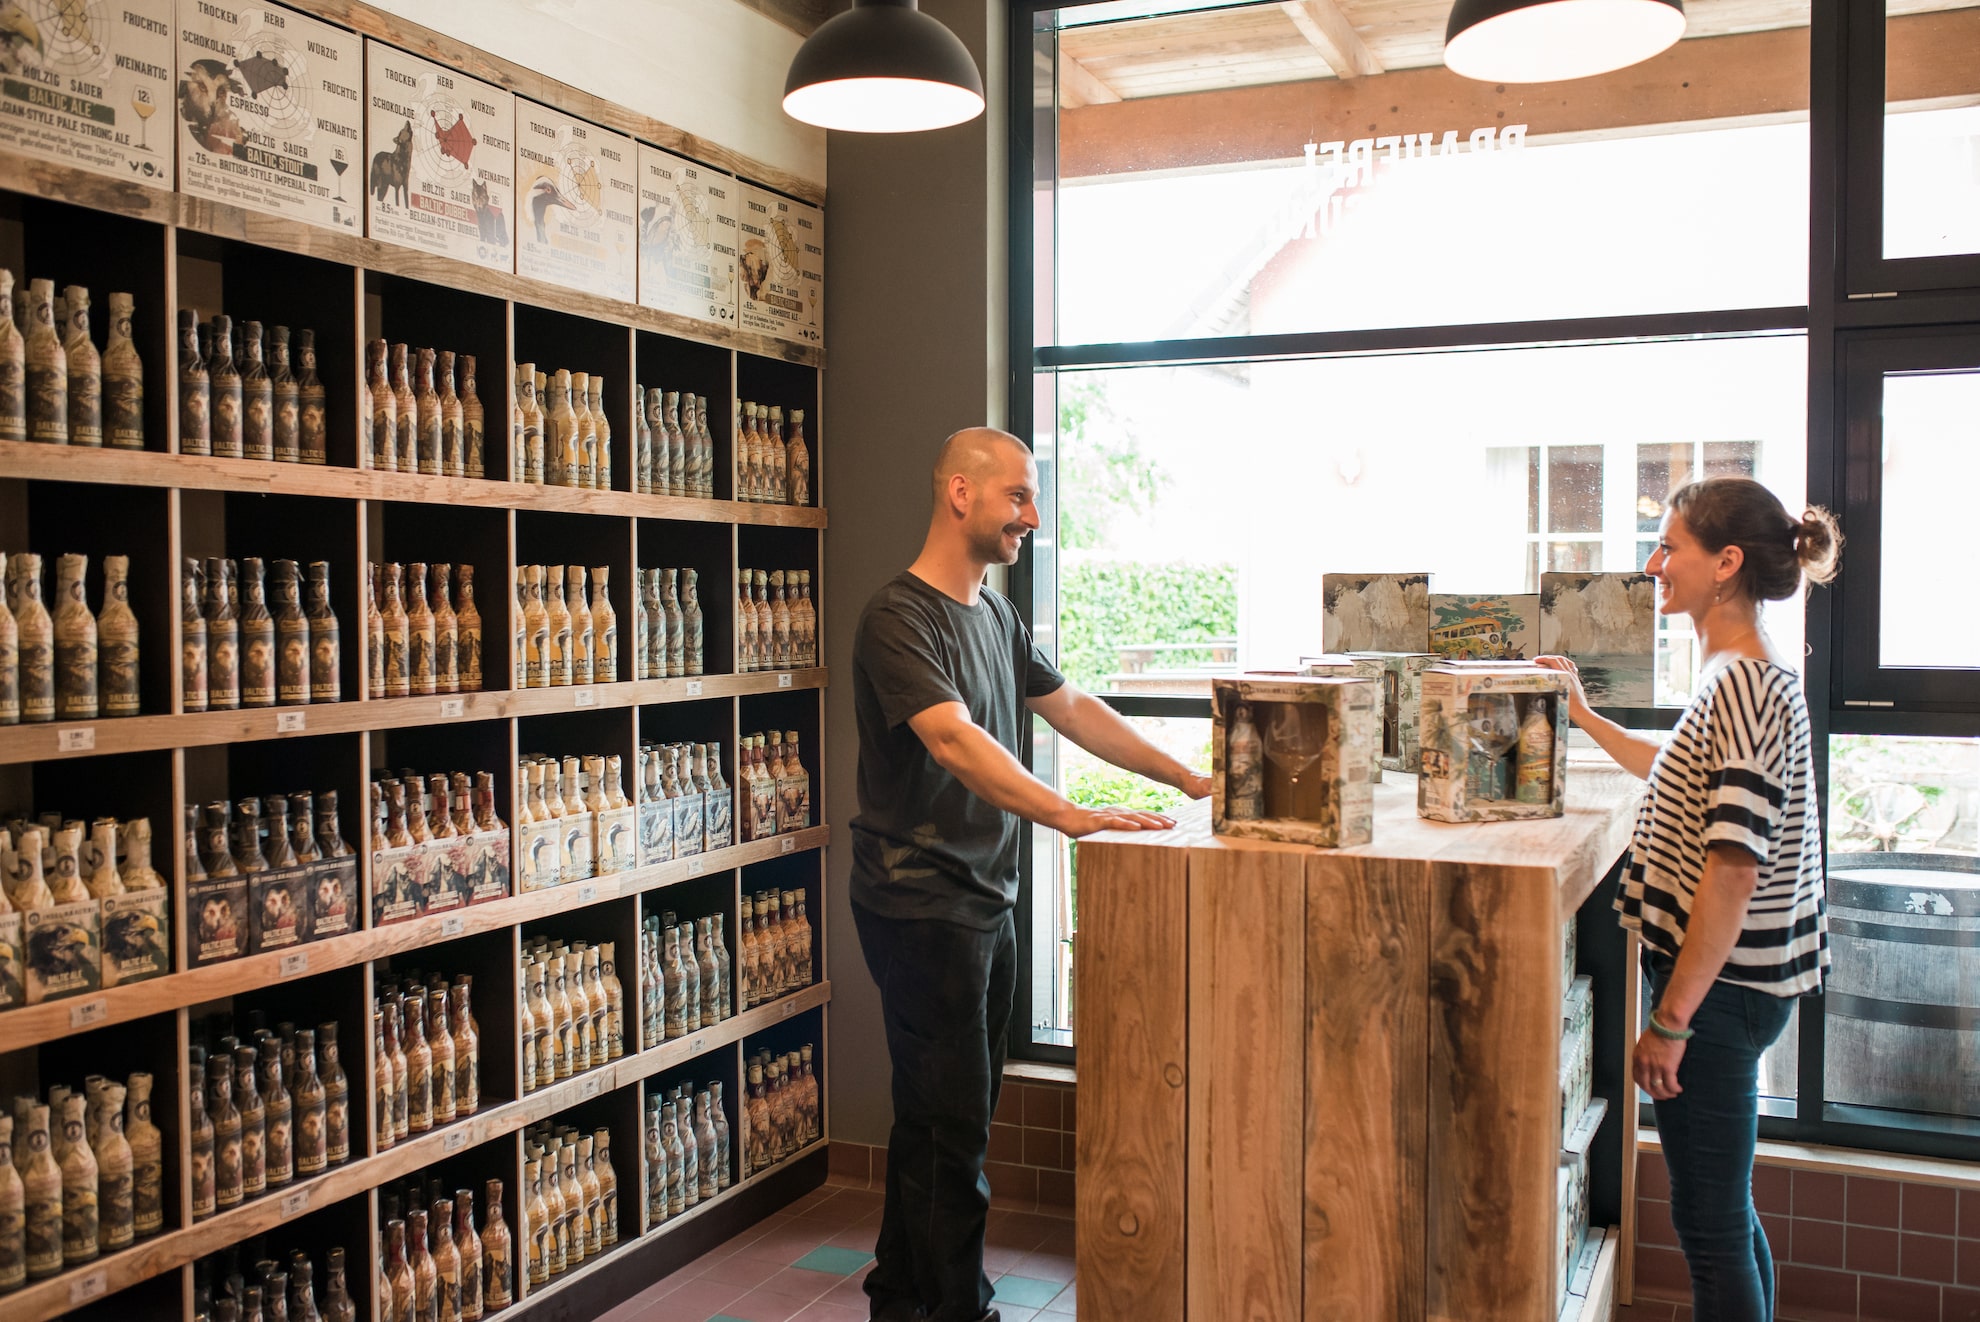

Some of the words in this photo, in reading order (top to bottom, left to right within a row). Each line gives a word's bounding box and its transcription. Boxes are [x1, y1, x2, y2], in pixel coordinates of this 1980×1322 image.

[123, 11, 168, 36] FRUCHTIG
[198, 1, 238, 25] TROCKEN
[264, 11, 285, 28] HERB
[182, 30, 237, 58] SCHOKOLADE
[115, 54, 168, 81] WEINARTIG
[70, 79, 103, 99] SAUER
[385, 68, 416, 88] TROCKEN
[437, 74, 454, 89] HERB
[322, 80, 357, 101] FRUCHTIG
[28, 87, 67, 110] BALTIC
[71, 97, 93, 118] ALE
[230, 96, 269, 117] ESPRESSO
[372, 96, 415, 119] SCHOKOLADE
[57, 116, 78, 132] PALE
[80, 123, 113, 142] STRONG
[115, 132, 130, 146] ALE
[317, 118, 357, 140] WEINARTIG
[530, 121, 555, 139] TROCKEN
[572, 126, 586, 139] HERB
[283, 141, 308, 158] SAUER
[482, 134, 510, 152] FRUCHTIG
[247, 149, 276, 168] BALTIC
[278, 157, 305, 176] STOUT
[520, 147, 554, 167] SCHOKOLADE
[219, 158, 273, 183] BRITISH-STYLE
[274, 174, 307, 192] IMPERIAL
[309, 184, 330, 198] STOUT
[477, 168, 510, 187] WEINARTIG
[650, 165, 671, 180] TROCKEN
[685, 168, 697, 179] HERB
[610, 178, 634, 194] FRUCHTIG
[419, 195, 444, 213] BALTIC
[450, 190, 470, 205] SAUER
[748, 200, 766, 213] TROCKEN
[409, 209, 456, 231] BELGIAN-STYLE
[457, 222, 479, 238] DUBBEL
[716, 214, 736, 228] FRUCHTIG
[713, 242, 736, 256] WEINARTIG
